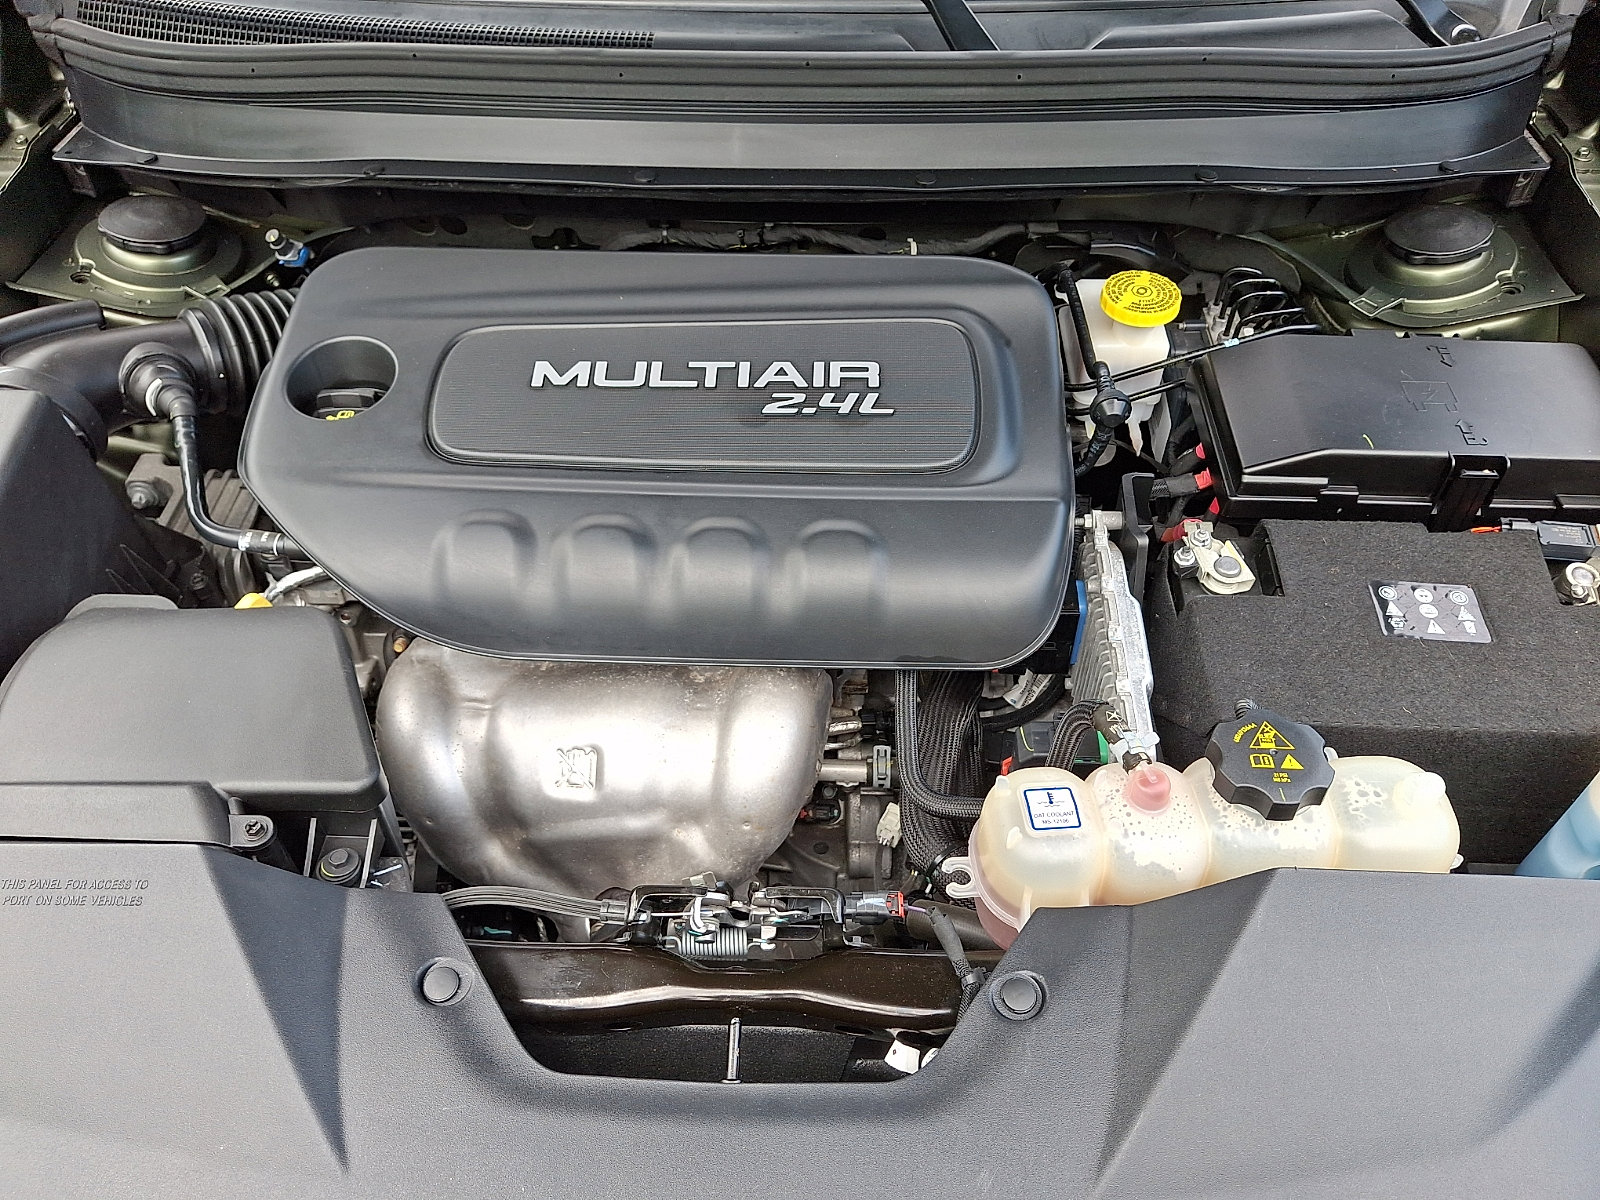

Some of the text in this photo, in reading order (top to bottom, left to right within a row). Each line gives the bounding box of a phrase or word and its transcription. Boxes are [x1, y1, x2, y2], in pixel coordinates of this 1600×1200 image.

[530, 360, 881, 388] MULTIAIR
[761, 391, 896, 416] 2.4L
[1046, 810, 1074, 818] COOLANT
[1, 879, 149, 890] THIS PANEL FOR ACCESS TO
[2, 895, 143, 907] PORT ON SOME VEHICLES
